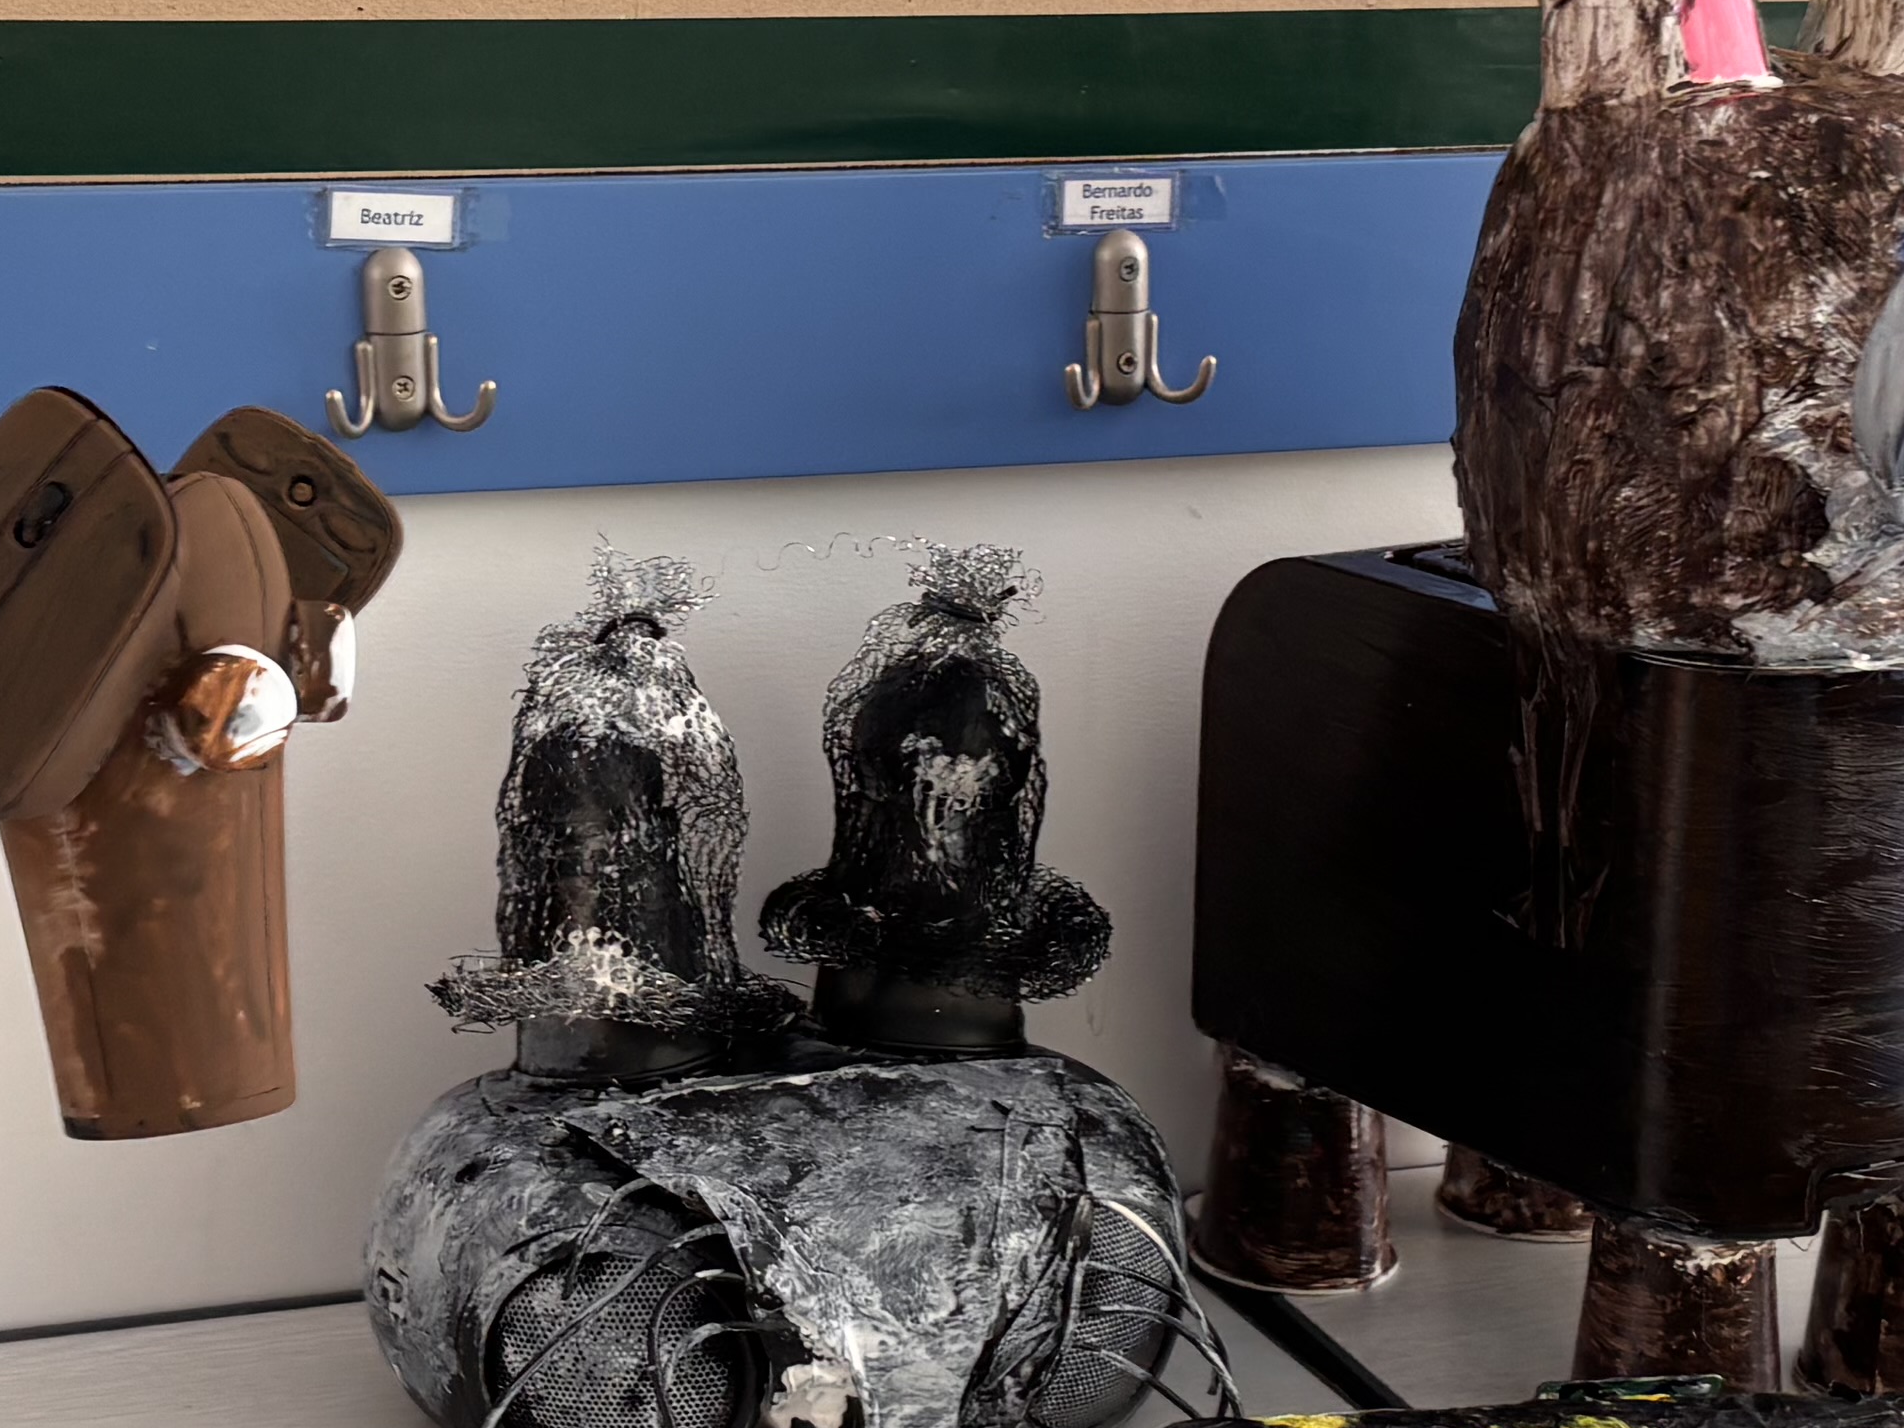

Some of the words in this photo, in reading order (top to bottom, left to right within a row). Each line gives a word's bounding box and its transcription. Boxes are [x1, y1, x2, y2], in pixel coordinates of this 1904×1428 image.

[1083, 183, 1153, 198] Bernardo
[360, 208, 424, 226] Beatriz
[1090, 206, 1143, 220] Freitas
